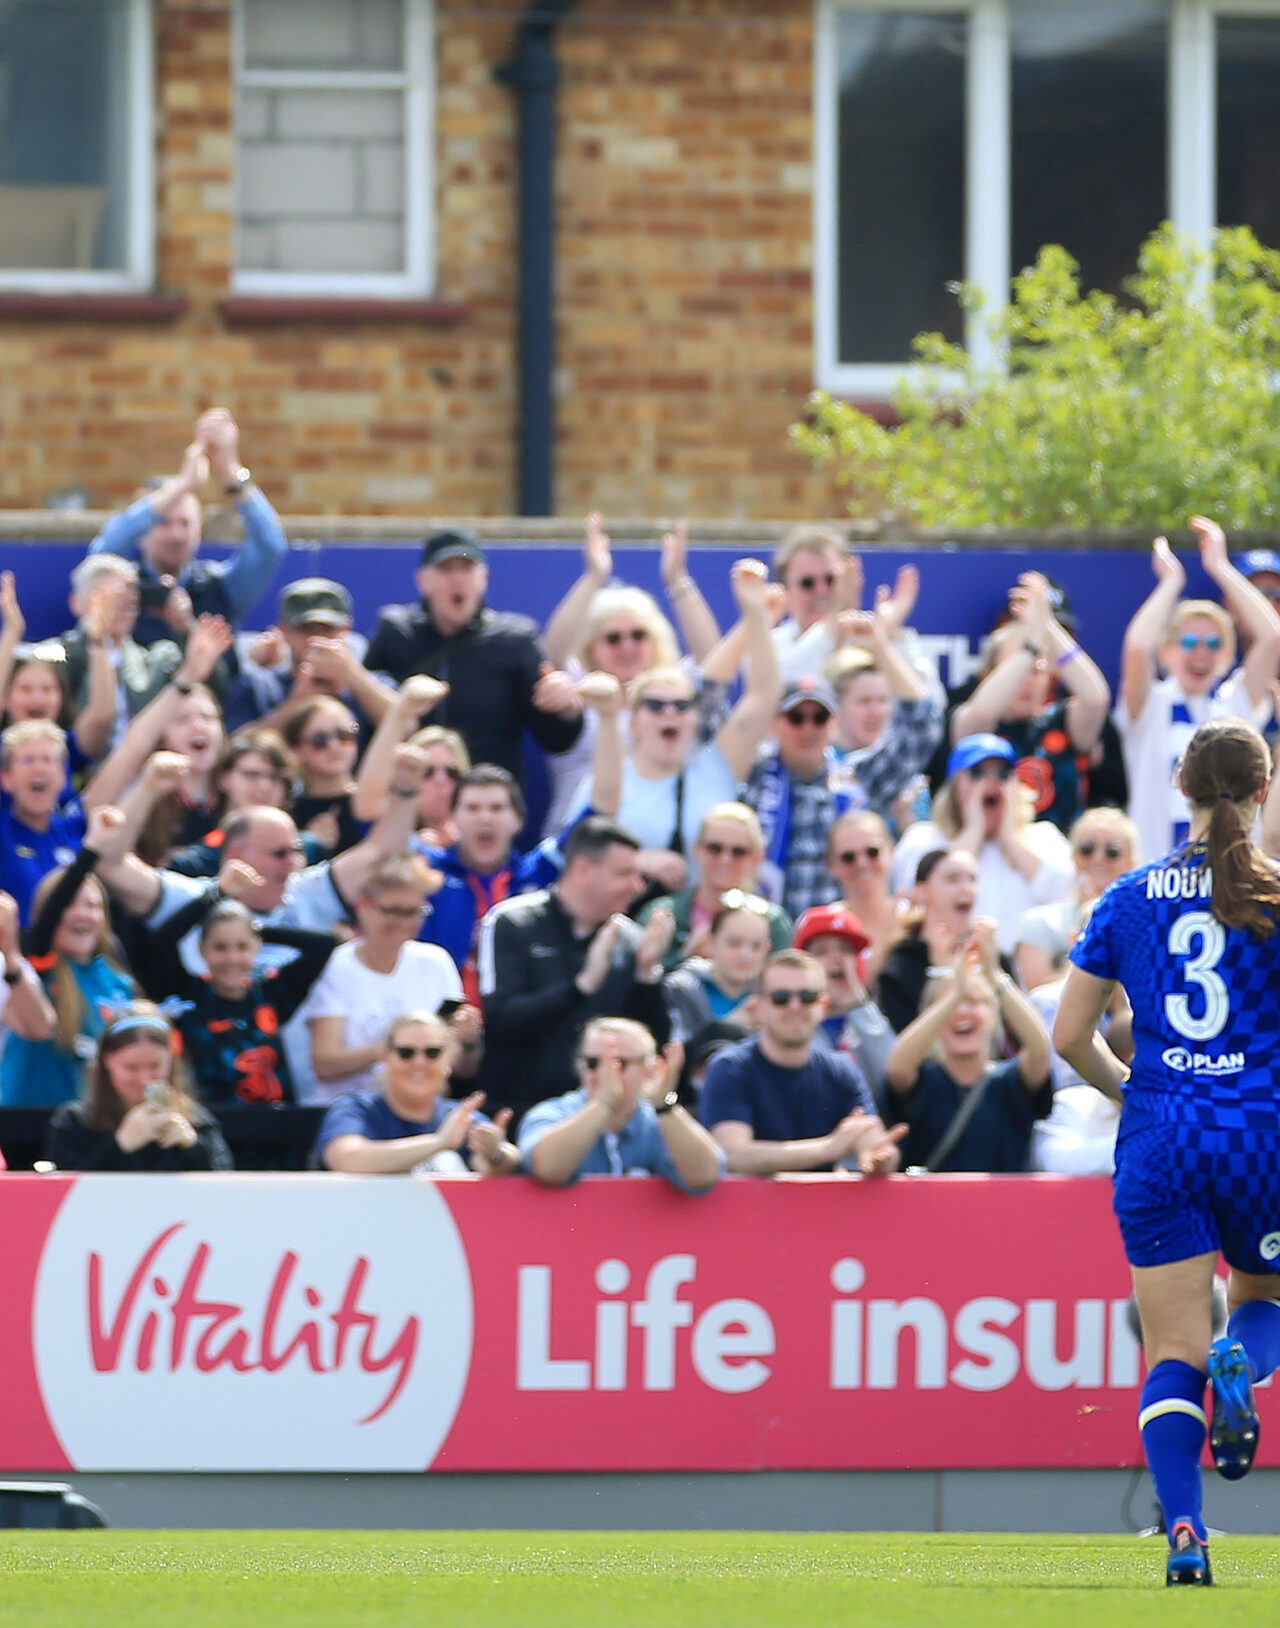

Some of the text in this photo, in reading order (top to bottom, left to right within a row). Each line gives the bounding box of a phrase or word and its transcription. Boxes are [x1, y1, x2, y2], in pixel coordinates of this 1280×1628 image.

[1165, 911, 1229, 1042] 3
[1193, 1052, 1245, 1069] PLAN
[86, 1221, 420, 1426] Vitality
[517, 1254, 777, 1393] Life
